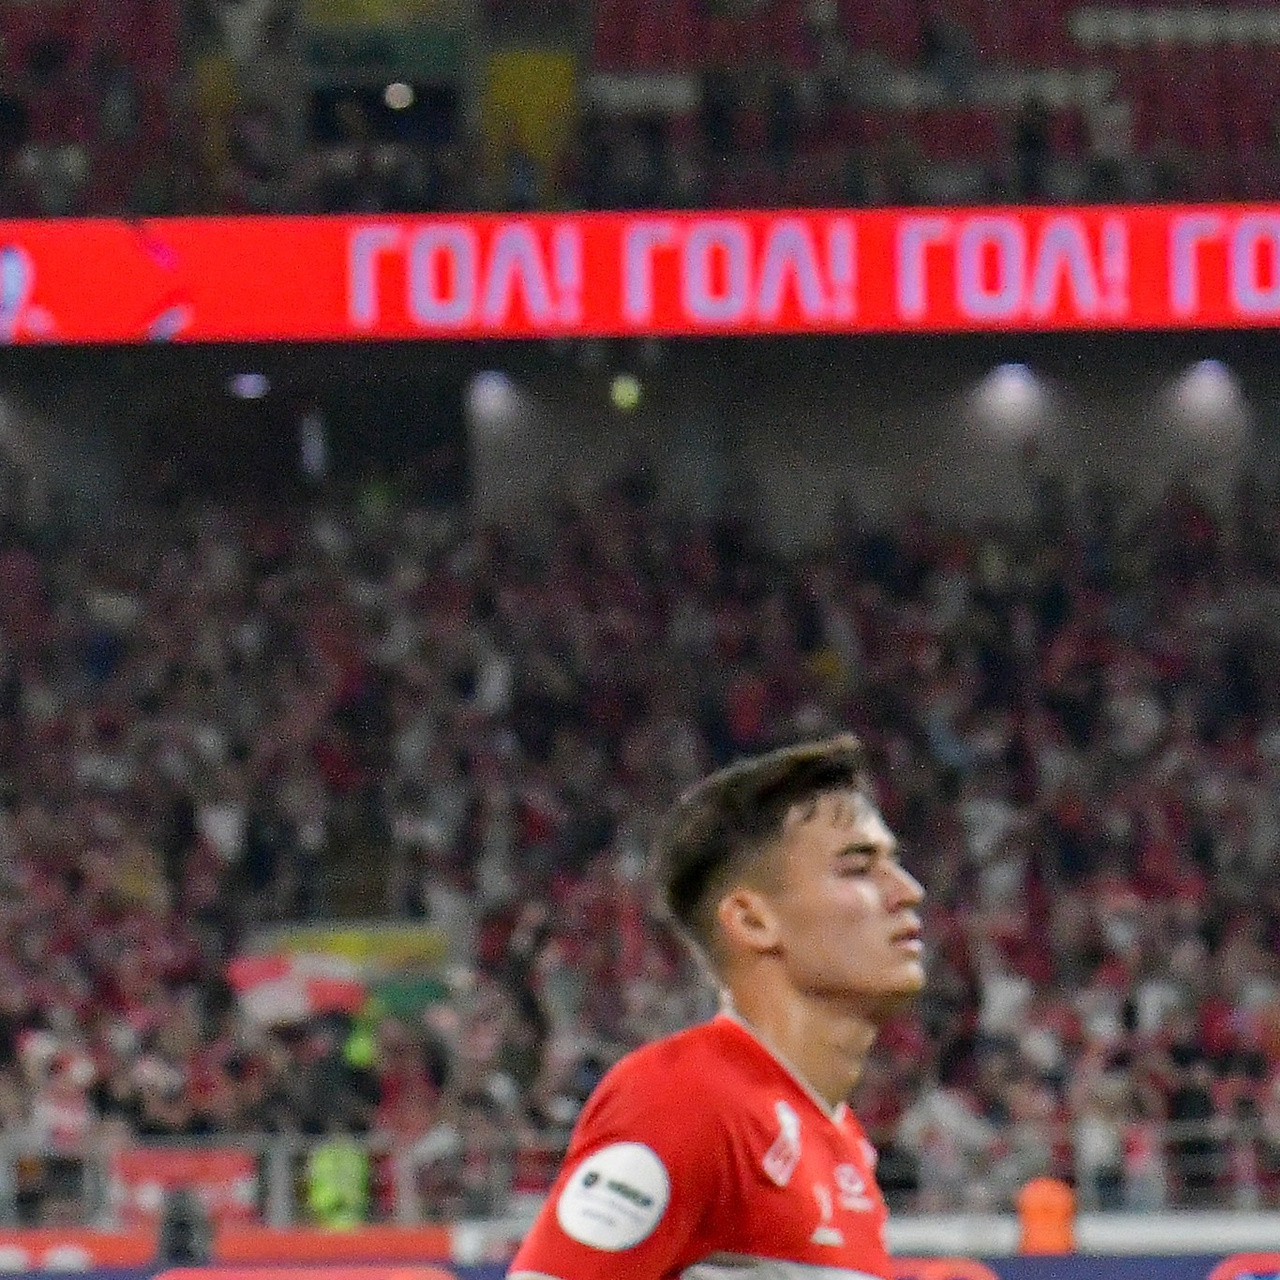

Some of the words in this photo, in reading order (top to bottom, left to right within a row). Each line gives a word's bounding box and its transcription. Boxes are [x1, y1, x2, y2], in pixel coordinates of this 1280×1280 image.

[347, 222, 583, 328] ГОЛ!
[621, 219, 857, 325] ГОЛ!
[894, 216, 1128, 321] ГОЛ!
